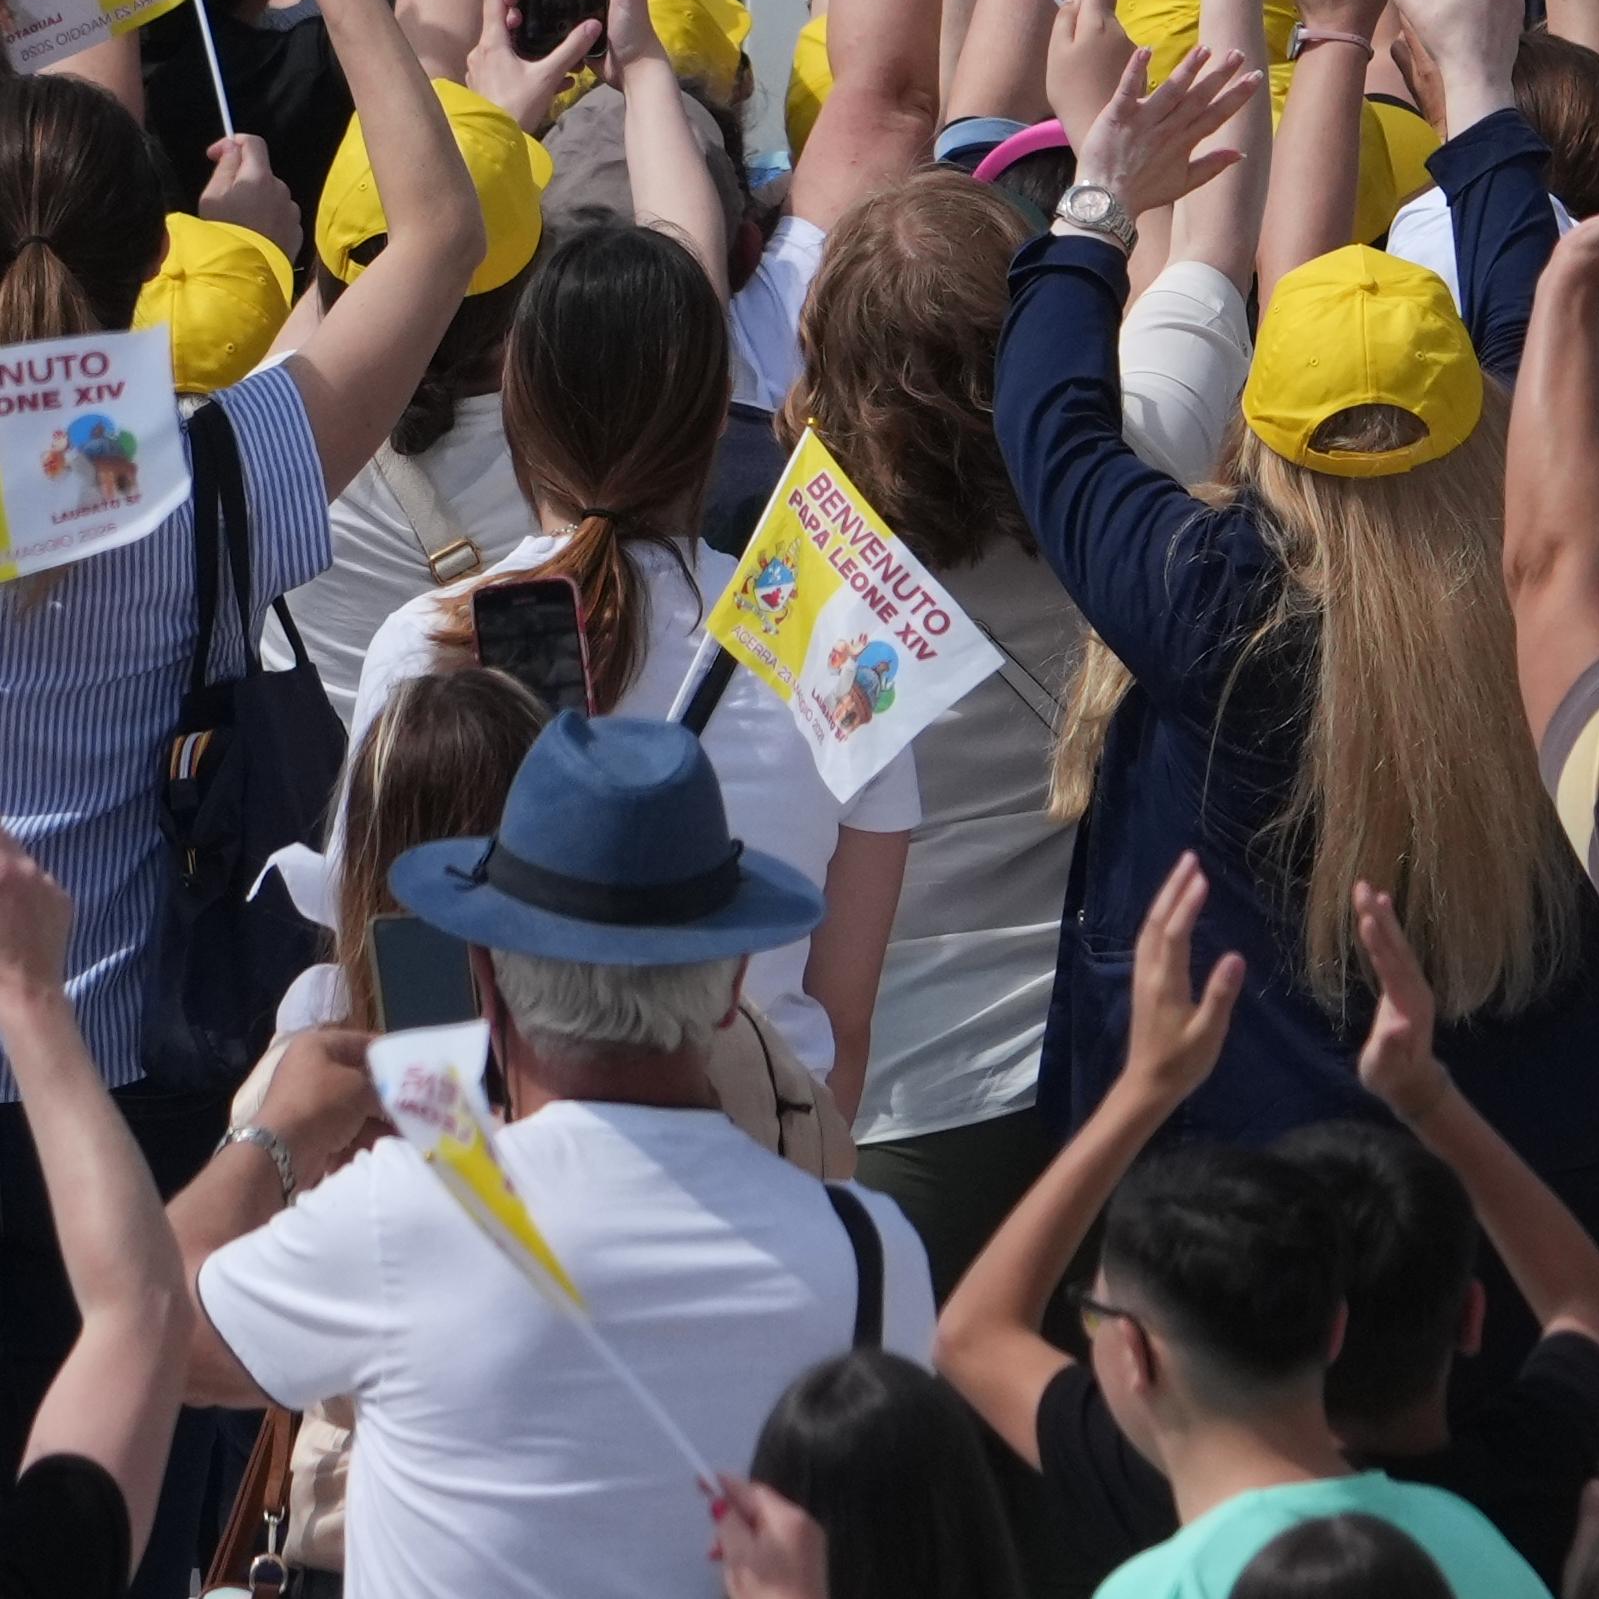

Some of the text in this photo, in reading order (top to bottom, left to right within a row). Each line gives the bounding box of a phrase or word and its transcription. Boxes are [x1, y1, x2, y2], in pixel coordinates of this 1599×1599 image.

[75, 381, 126, 407] XIV
[787, 489, 938, 662] PAPA LEONE XIV
[806, 472, 951, 636] BENVENUTO
[731, 624, 778, 671] ACERRA
